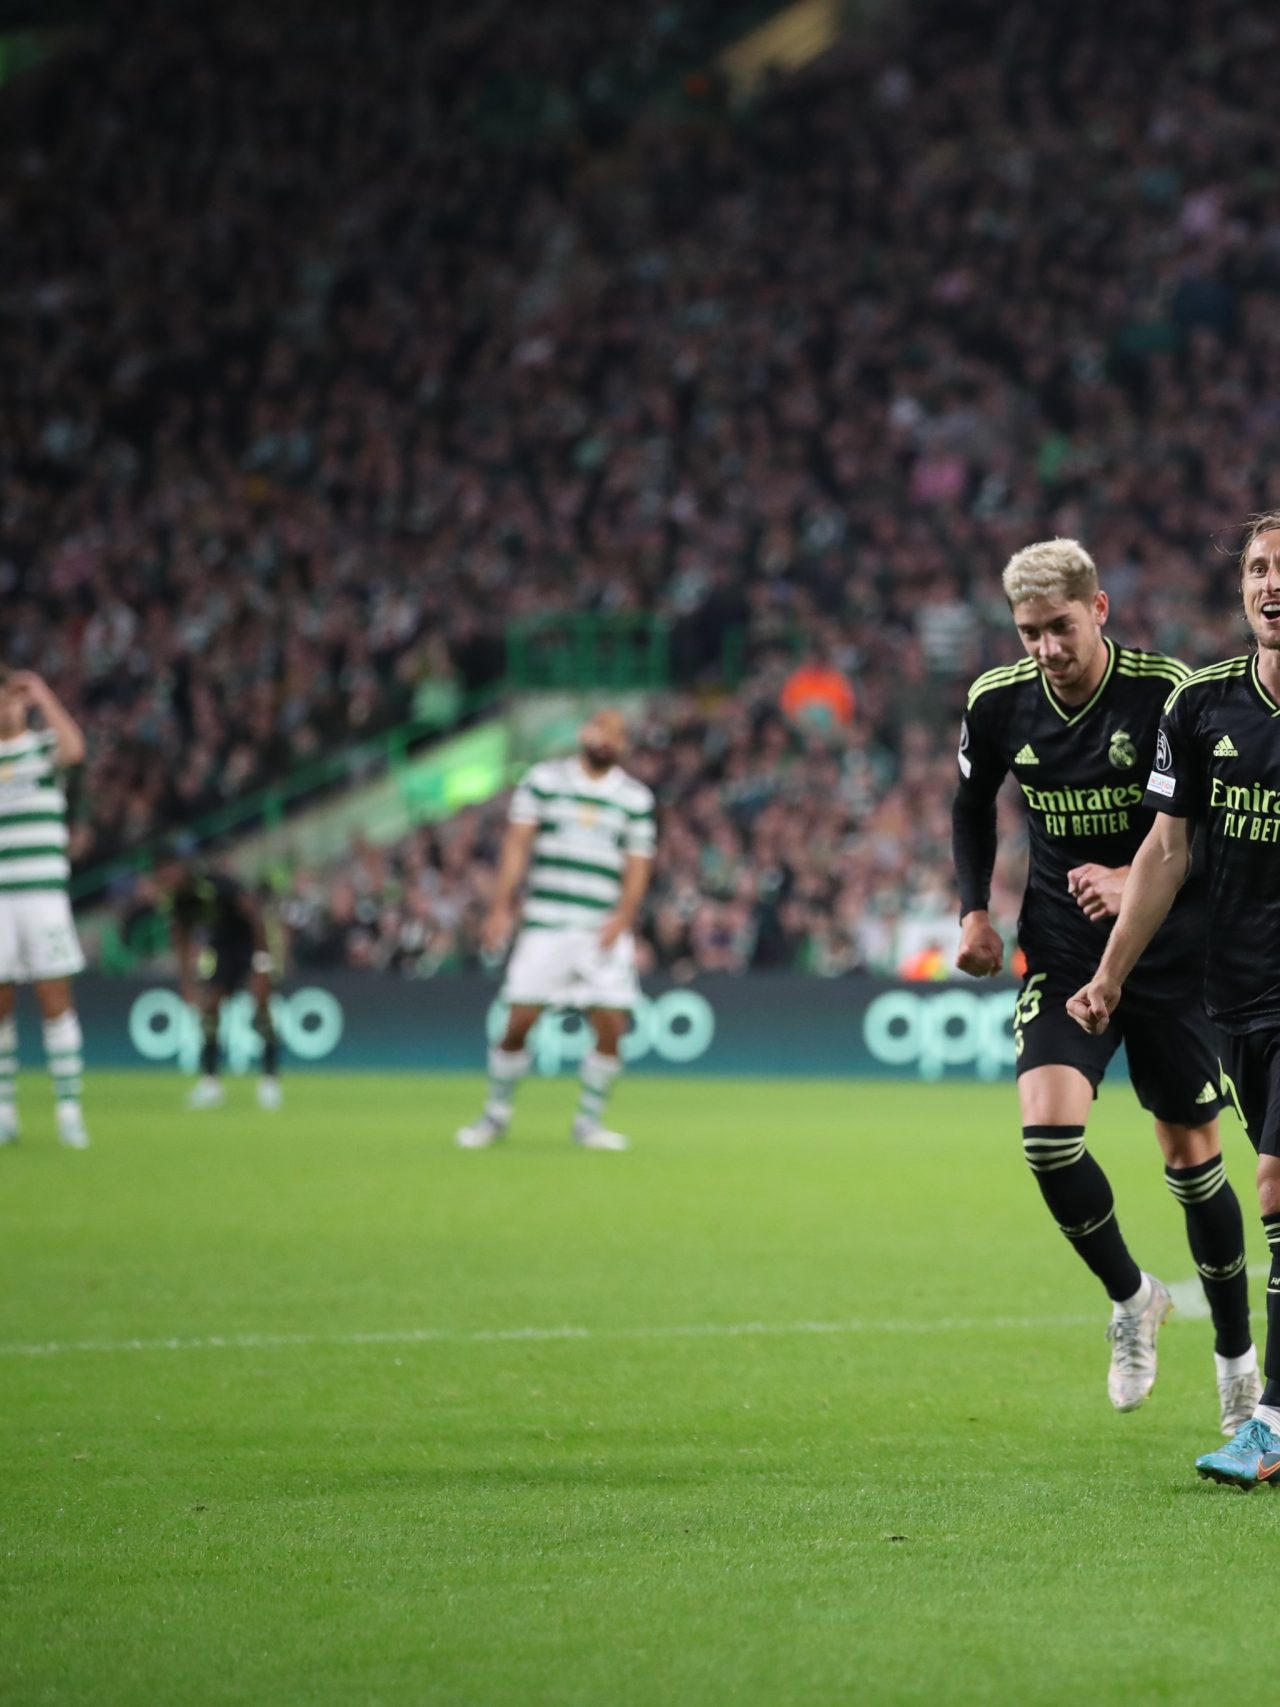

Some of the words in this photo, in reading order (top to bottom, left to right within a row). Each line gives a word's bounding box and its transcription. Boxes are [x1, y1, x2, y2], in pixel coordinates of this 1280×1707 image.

[1021, 782, 1144, 812] Emirates
[1046, 815, 1066, 837] FLY
[1072, 811, 1130, 836] BETTER
[1224, 812, 1246, 839] FLY
[863, 989, 1018, 1082] opp
